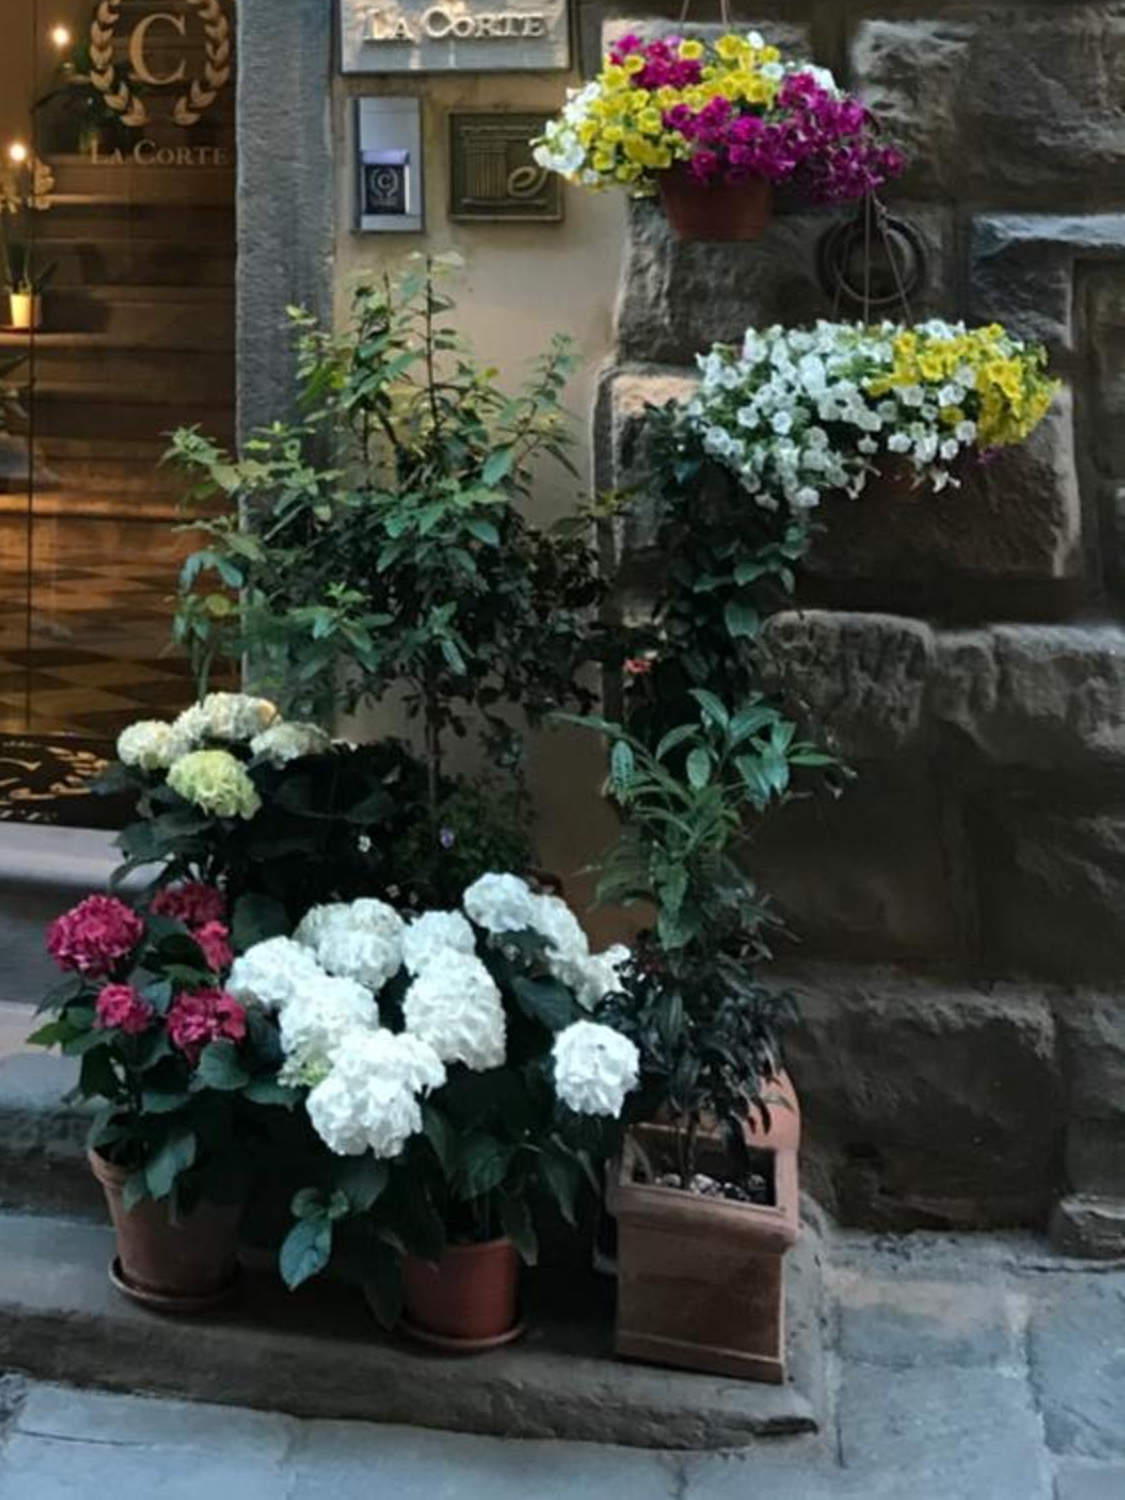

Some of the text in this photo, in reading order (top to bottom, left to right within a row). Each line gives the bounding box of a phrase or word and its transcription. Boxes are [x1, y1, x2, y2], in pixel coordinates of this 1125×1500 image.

[425, 6, 546, 39] CORTE
[129, 12, 187, 86] C
[133, 138, 230, 165] CORTE
